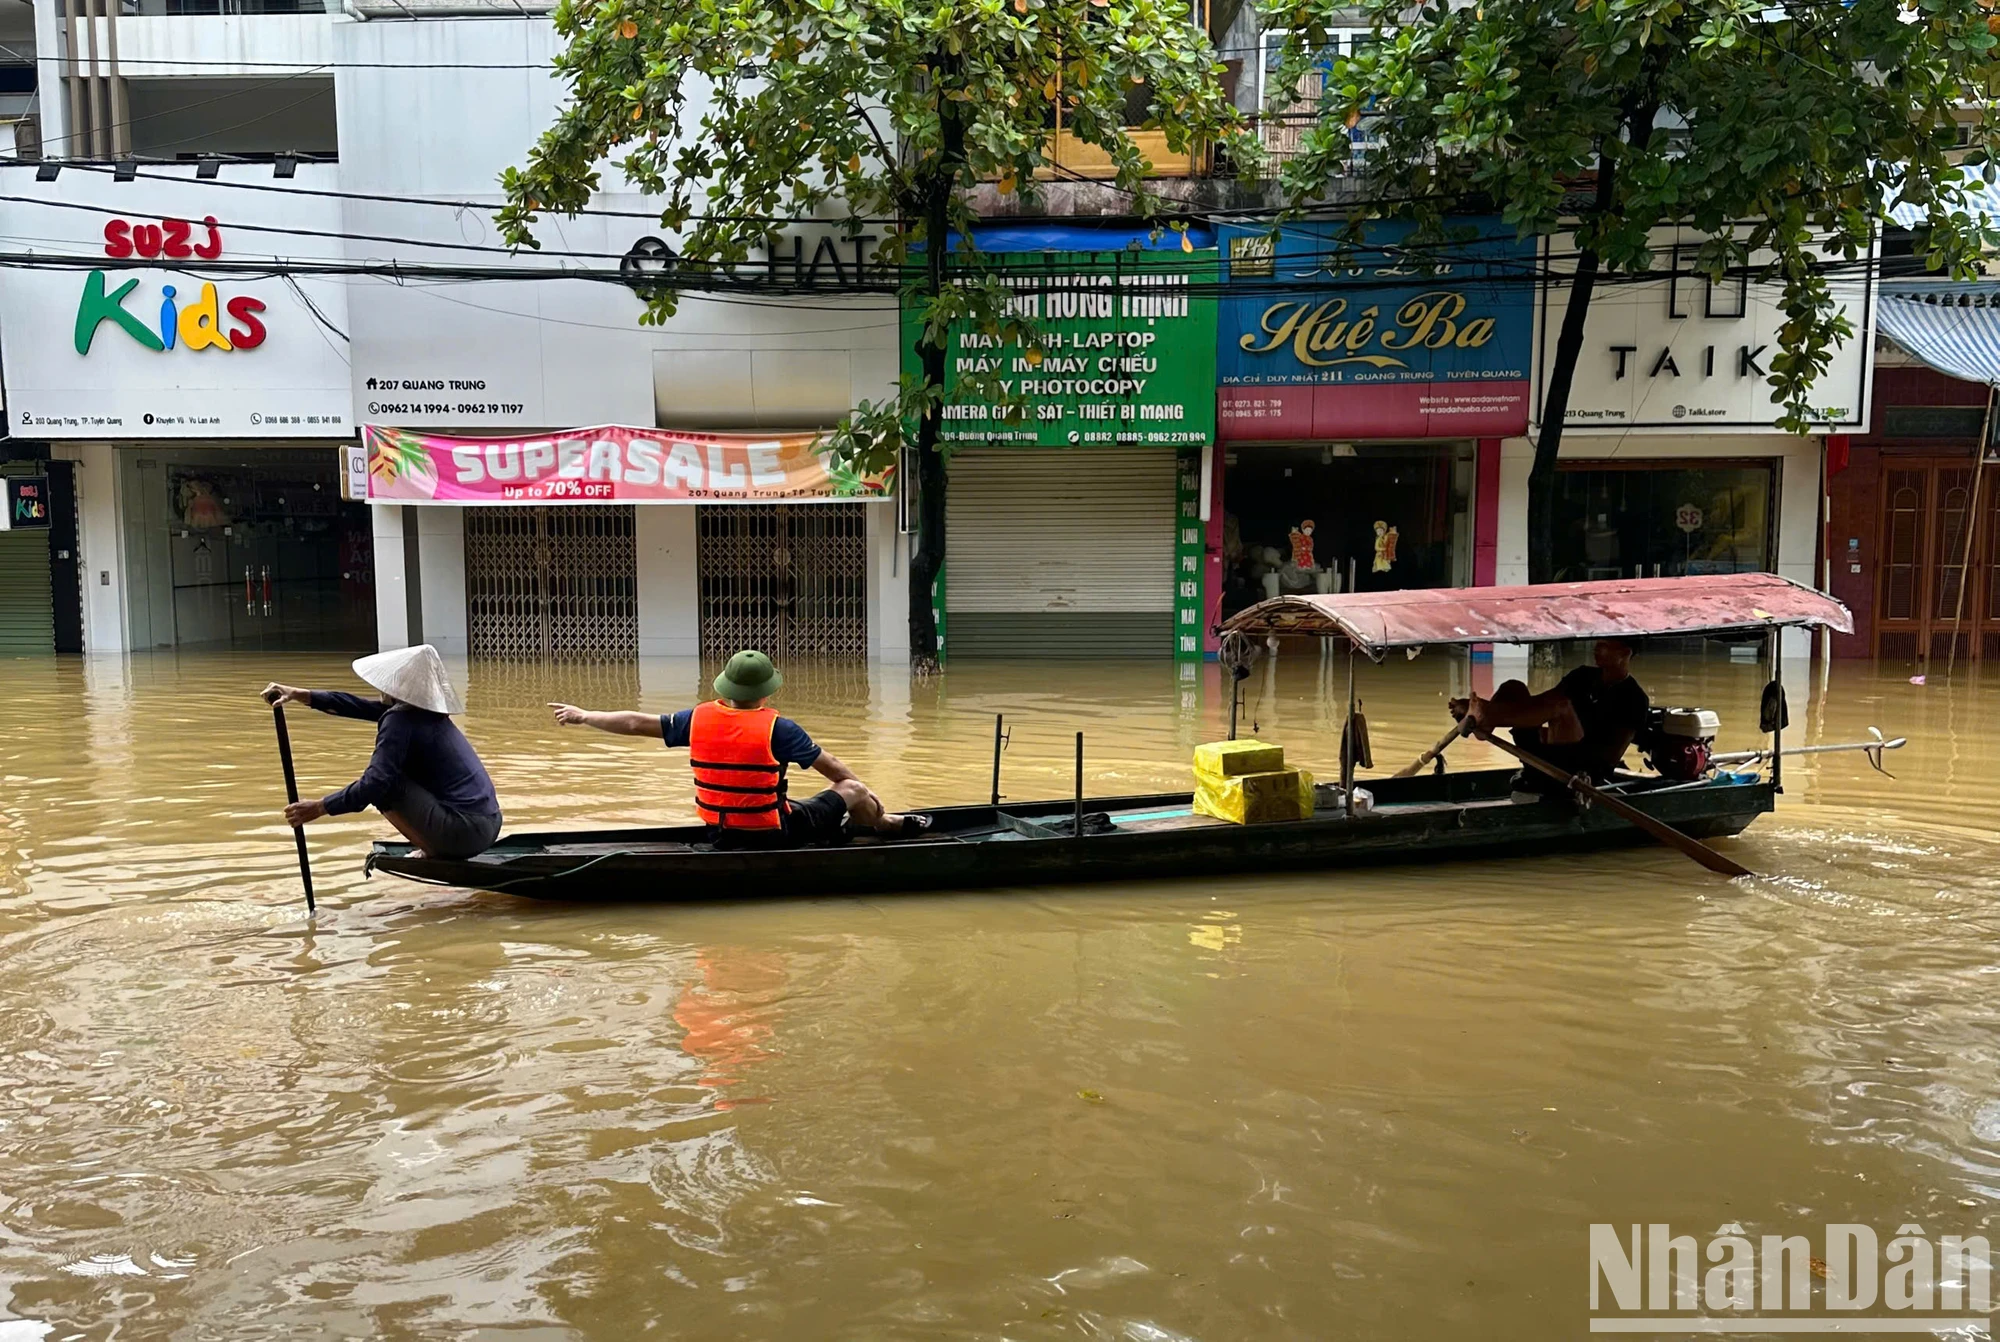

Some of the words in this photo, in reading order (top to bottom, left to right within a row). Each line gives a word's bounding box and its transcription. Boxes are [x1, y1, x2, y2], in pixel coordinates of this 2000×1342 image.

[1045, 273, 1113, 318] HƯNG
[1119, 274, 1188, 326] THỊNH
[74, 268, 267, 356] Kids
[1240, 298, 1408, 368] Huệ
[1380, 291, 1496, 350] Ba
[956, 353, 1003, 373] MÁY
[379, 380, 399, 390] 207
[402, 380, 445, 390] QUANG
[448, 380, 486, 390] TRUNG
[1266, 375, 1288, 383] DUY
[1321, 371, 1343, 381] 211
[1354, 372, 1396, 381] QUANG
[1400, 371, 1434, 379] TRUNG
[1481, 370, 1522, 378] QUANG
[1020, 379, 1147, 395] PHOTOCOPY
[380, 403, 409, 414] 0962
[411, 403, 422, 414] 14
[423, 403, 450, 414] 1994
[457, 403, 486, 414] 0962
[487, 403, 499, 414] 19
[501, 403, 524, 414] 1197
[1036, 401, 1064, 420] SÁT
[1078, 399, 1117, 420] THIẾT
[1120, 404, 1136, 423] BỊ
[1140, 404, 1184, 423] MẠNG
[1578, 410, 1604, 419] Quang
[1605, 409, 1626, 419] Trung
[46, 417, 62, 426] Quang
[106, 417, 122, 426] Quang
[197, 416, 208, 424] Lan
[209, 416, 220, 424] Anh
[1171, 432, 1188, 442] 270
[452, 439, 785, 489] SUPERSALE
[504, 486, 524, 499] Up
[528, 487, 542, 497] to
[545, 482, 581, 497] 70%
[584, 485, 611, 497] OFF
[713, 490, 748, 498] Quang
[1182, 528, 1198, 544] LINH
[1182, 556, 1197, 575] PHỤ
[1180, 578, 1197, 600] KIỆN
[1181, 607, 1196, 625] MÁY
[1180, 633, 1196, 652] TÍNH
